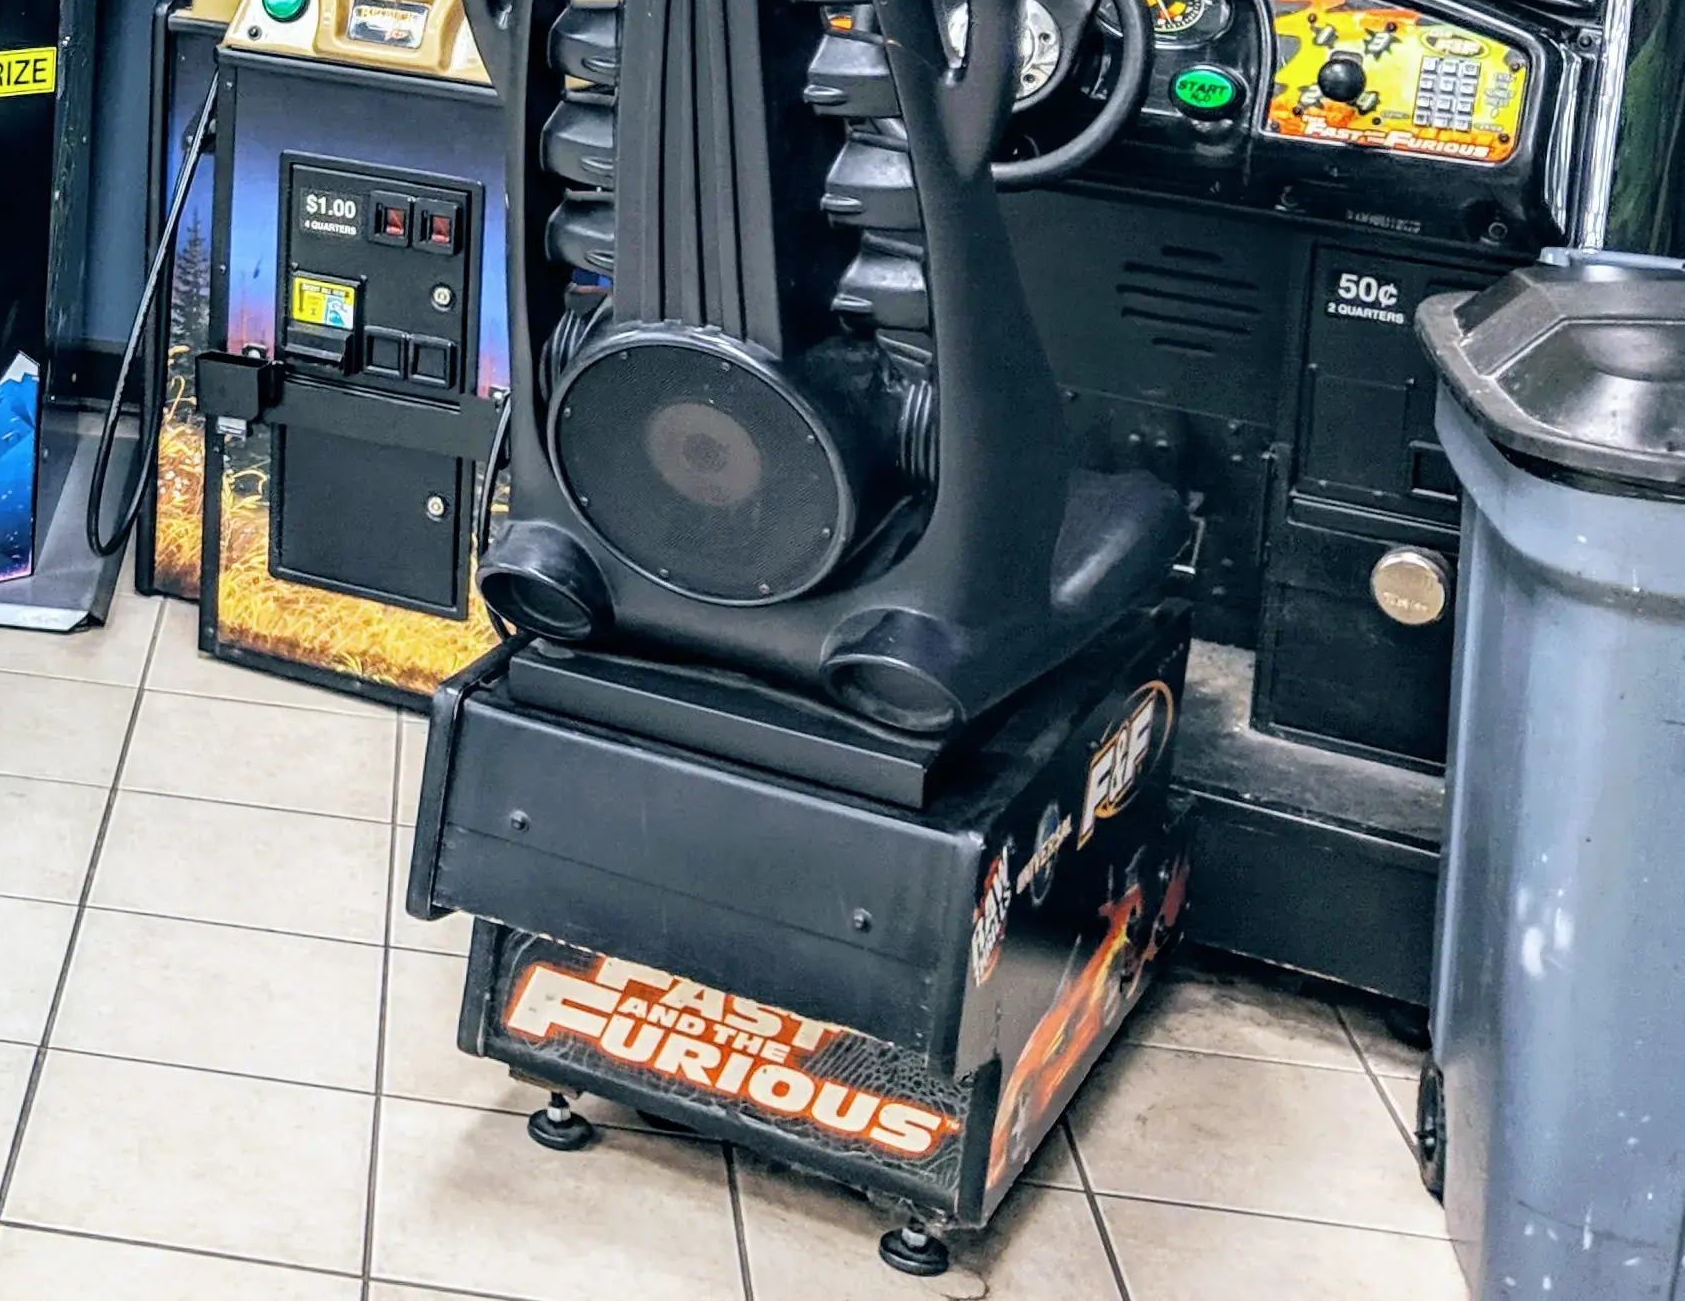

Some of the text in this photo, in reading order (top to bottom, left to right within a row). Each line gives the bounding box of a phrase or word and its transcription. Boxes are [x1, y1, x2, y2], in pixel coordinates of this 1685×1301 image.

[1177, 79, 1229, 98] START
[1304, 120, 1363, 143] FAST
[1383, 130, 1490, 158] FURIOUS
[306, 193, 357, 220] $1.00
[304, 219, 358, 237] 4 QUARTERS
[1337, 273, 1398, 307] 50¢
[1327, 302, 1405, 326] 2 QUARTERS
[1077, 690, 1158, 850] F&F
[595, 955, 835, 1051] FAST
[617, 998, 791, 1064] AND THE
[508, 965, 943, 1153] FURIOUS
